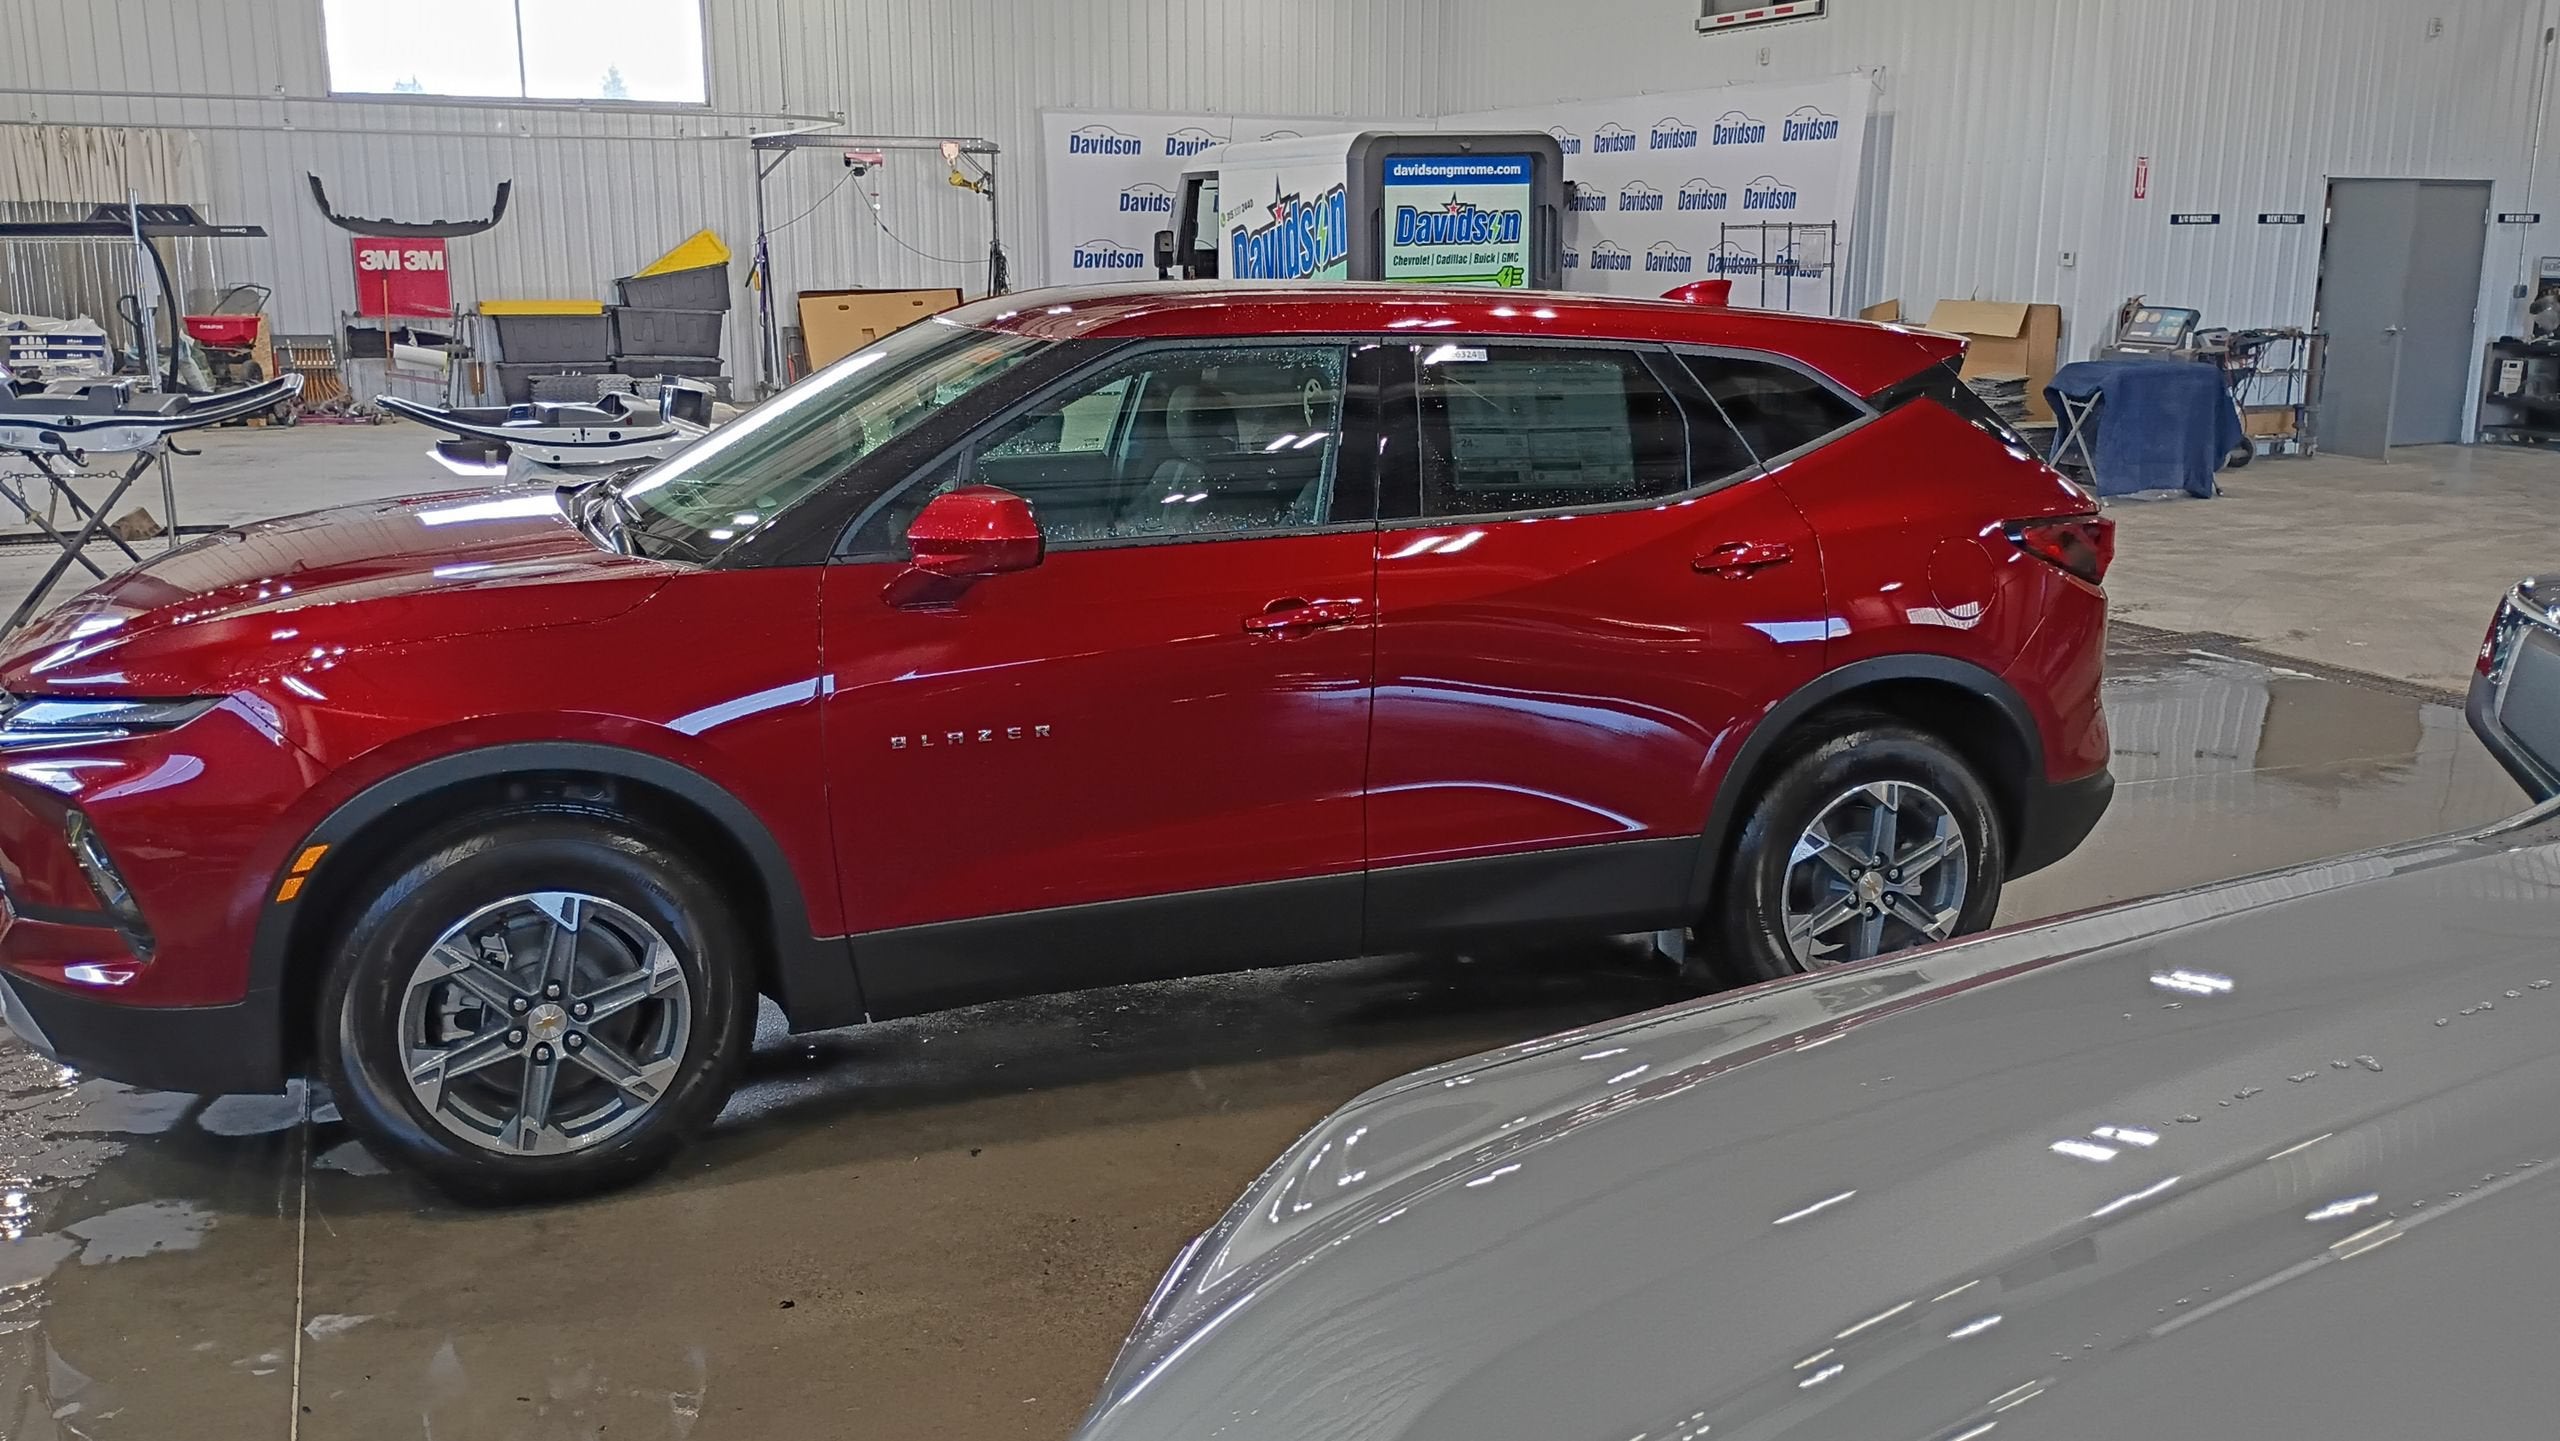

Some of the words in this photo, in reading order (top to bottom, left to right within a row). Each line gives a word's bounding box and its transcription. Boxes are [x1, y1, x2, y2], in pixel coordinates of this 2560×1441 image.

[1650, 128, 1697, 150] Davidson
[1713, 122, 1765, 145] Davidson
[1783, 117, 1838, 143] Davidson
[1070, 134, 1141, 155] Davidson
[1593, 132, 1636, 154] Davidson
[1393, 163, 1521, 178] davidsongmrome.com
[1120, 192, 1176, 212] Davids
[1619, 191, 1663, 211] Davidson
[1678, 188, 1727, 210] Davidson
[1744, 187, 1796, 210] Davidson
[1232, 184, 1347, 279] Davidson
[1394, 203, 1522, 246] Davidson
[360, 249, 401, 271] 3M
[403, 250, 445, 271] 3M
[1074, 248, 1144, 269] Davidson
[1393, 254, 1430, 266] Chevrolet
[1436, 253, 1467, 265] Cadillac
[1474, 253, 1495, 263] Buick
[1501, 252, 1519, 263] GMC
[1591, 250, 1631, 271] Davidson
[1645, 251, 1691, 272] Davidson
[1707, 252, 1758, 275] Davidson
[891, 725, 1050, 749] BLAZER
